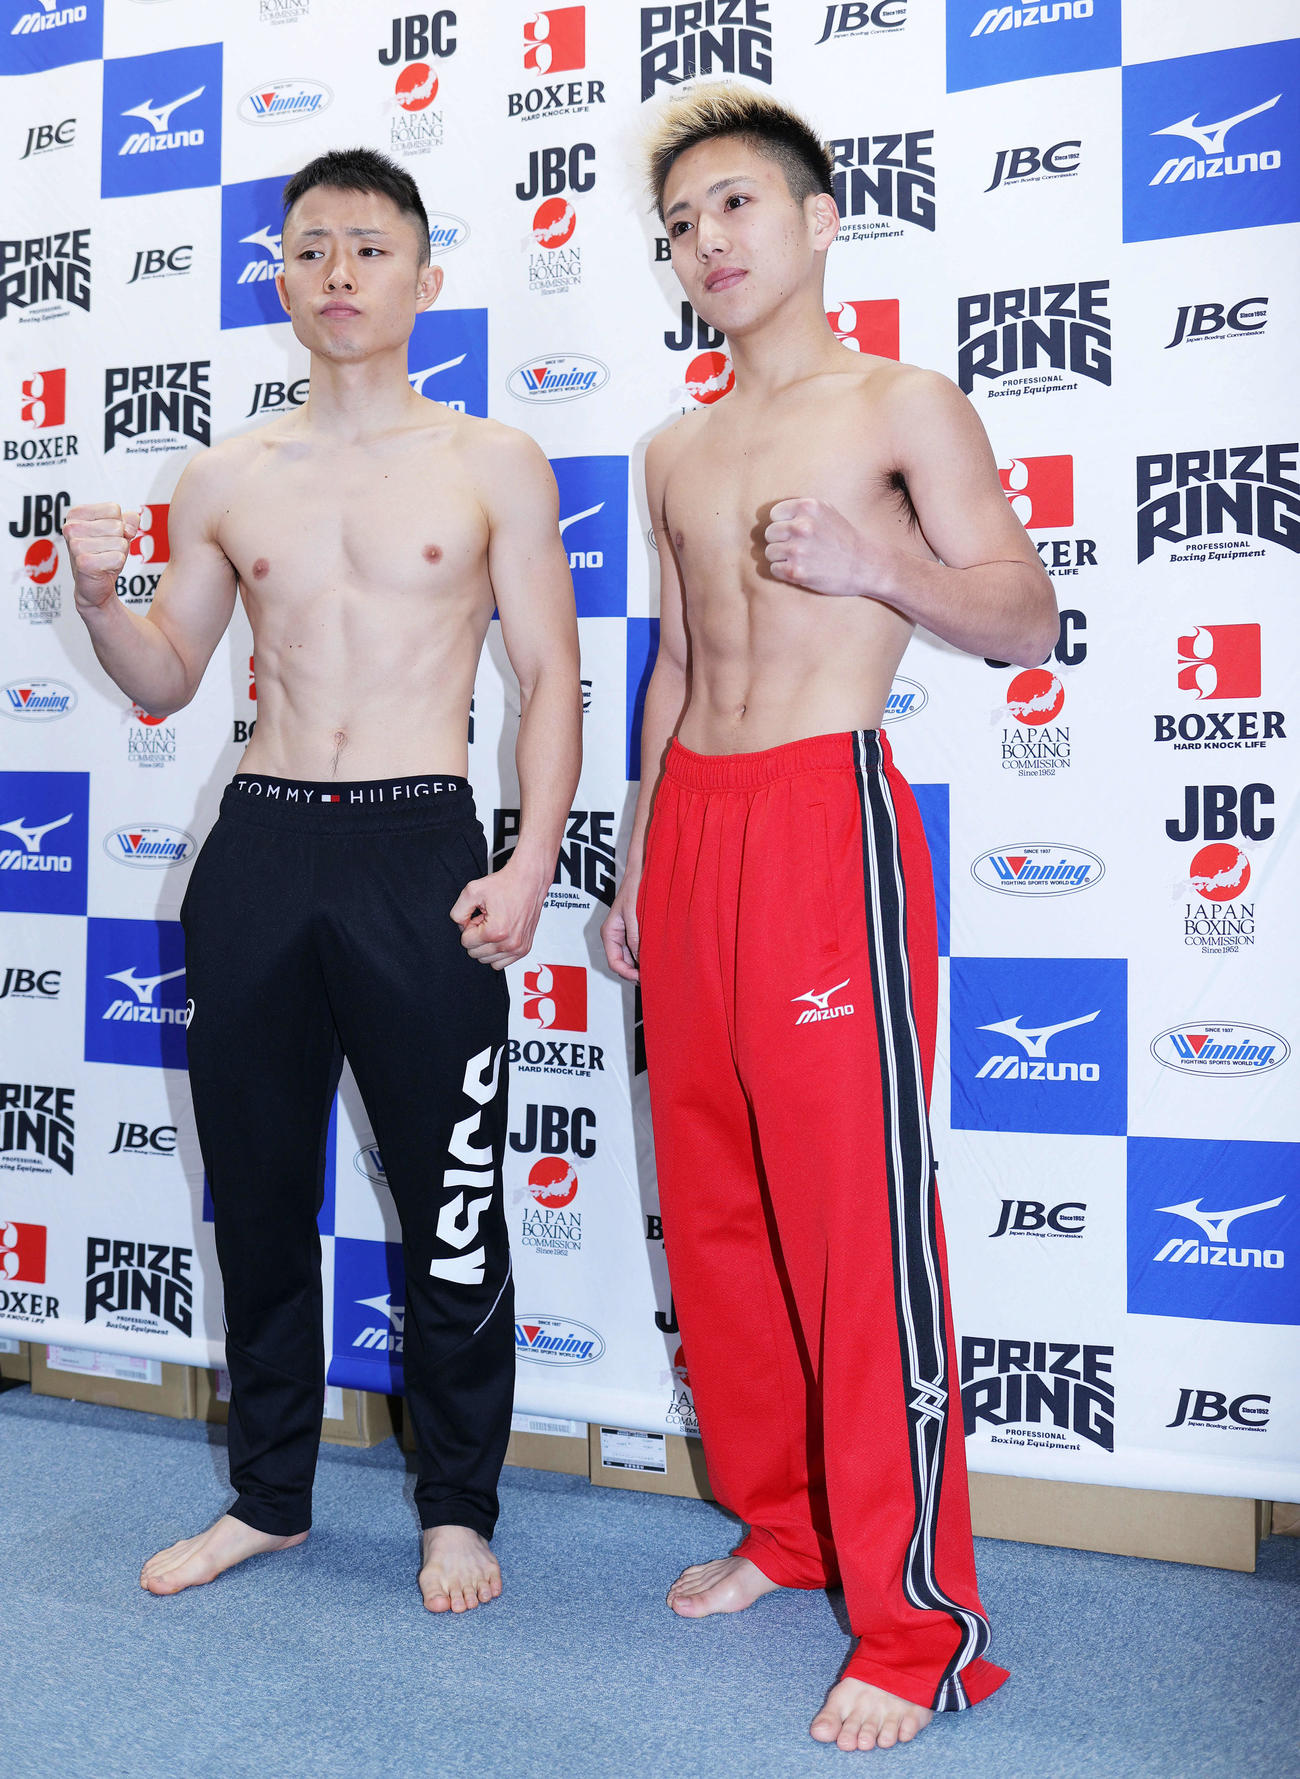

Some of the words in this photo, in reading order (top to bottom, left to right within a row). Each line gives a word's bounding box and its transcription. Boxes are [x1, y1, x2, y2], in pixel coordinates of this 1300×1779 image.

[378, 9, 457, 66] JBC
[640, 0, 772, 52] PRIZE
[814, 0, 908, 45] JBC
[640, 27, 772, 103] RING
[249, 90, 323, 113] Winning
[507, 80, 606, 117] BOXER
[520, 113, 541, 122] HARD
[19, 118, 77, 160] JBC
[829, 129, 935, 179] RIZE
[515, 142, 596, 201] JBC
[983, 140, 1082, 193] JBC
[832, 167, 936, 232] ING
[840, 222, 890, 231] OFESSIONAL
[852, 230, 904, 241] Equipment
[0, 228, 91, 278] PRIZE
[126, 245, 193, 285] JBC
[529, 247, 581, 267] JAPAN
[236, 259, 285, 285] MIZ
[528, 261, 582, 282] BOXING
[0, 260, 91, 320] RING
[664, 301, 726, 351] JB
[957, 279, 1111, 348] PRIZE
[1163, 297, 1269, 349] JBC
[957, 318, 1112, 397] RING
[104, 360, 211, 408] PRIZE
[520, 367, 597, 390] Winning
[987, 388, 1022, 399] Boxing
[1023, 383, 1079, 396] Equipment
[1002, 375, 1064, 387] PROFESSIONAL
[104, 390, 211, 455] RING
[3, 435, 78, 461] BOXER
[1136, 442, 1300, 509] PRIZE
[9, 491, 71, 538] JBC
[1136, 482, 1300, 565] RING
[1169, 553, 1206, 563] Boxing
[1208, 549, 1266, 560] Equipment
[1186, 541, 1250, 551] PROFESSIONAL
[115, 574, 162, 597] BOX
[6, 689, 70, 712] Winning
[128, 727, 176, 740] JAPAN
[1001, 726, 1070, 744] JAPAN
[1153, 711, 1287, 742] BOXER
[128, 740, 176, 754] BOXING
[1001, 742, 1071, 760] BOXING
[1204, 741, 1242, 749] KNOCK
[1001, 758, 1071, 770] COMMISSION
[238, 781, 314, 804] TOMMY
[1165, 782, 1275, 842] JBC
[116, 834, 188, 860] Winning
[493, 808, 615, 860] PZE
[988, 856, 1091, 885] Winning
[550, 900, 590, 909] Equipment
[1184, 903, 1255, 920] JAPAN
[1184, 918, 1255, 936] BOXING
[1184, 935, 1255, 946] COMMISSION
[0, 968, 61, 999] JBC
[507, 1039, 605, 1071] BOXER
[1169, 1034, 1276, 1067] Winning
[518, 1065, 542, 1073] HARD
[543, 1066, 573, 1075] KNOCK
[575, 1069, 591, 1077] LIFE
[0, 1083, 75, 1131] RIZE
[0, 1110, 75, 1176] ING
[109, 1122, 178, 1155] JBC
[508, 1103, 597, 1159] JBC
[522, 1208, 582, 1226] JAPAN
[522, 1222, 582, 1241] BOXING
[988, 1199, 1087, 1238] JBC
[521, 1237, 582, 1250] COMMISSION
[87, 1236, 193, 1292] PRIZE
[0, 1289, 60, 1319] OXER
[84, 1268, 193, 1339] RING
[351, 1326, 404, 1353] MIZ
[515, 1324, 595, 1359] Winning
[961, 1336, 1115, 1398] PRIZE
[961, 1373, 1115, 1453] RING
[1165, 1388, 1271, 1428] JBC
[990, 1435, 1025, 1446] Boxing
[1026, 1439, 1081, 1451] Equipment
[1005, 1428, 1066, 1440] PROFESSIONAL
